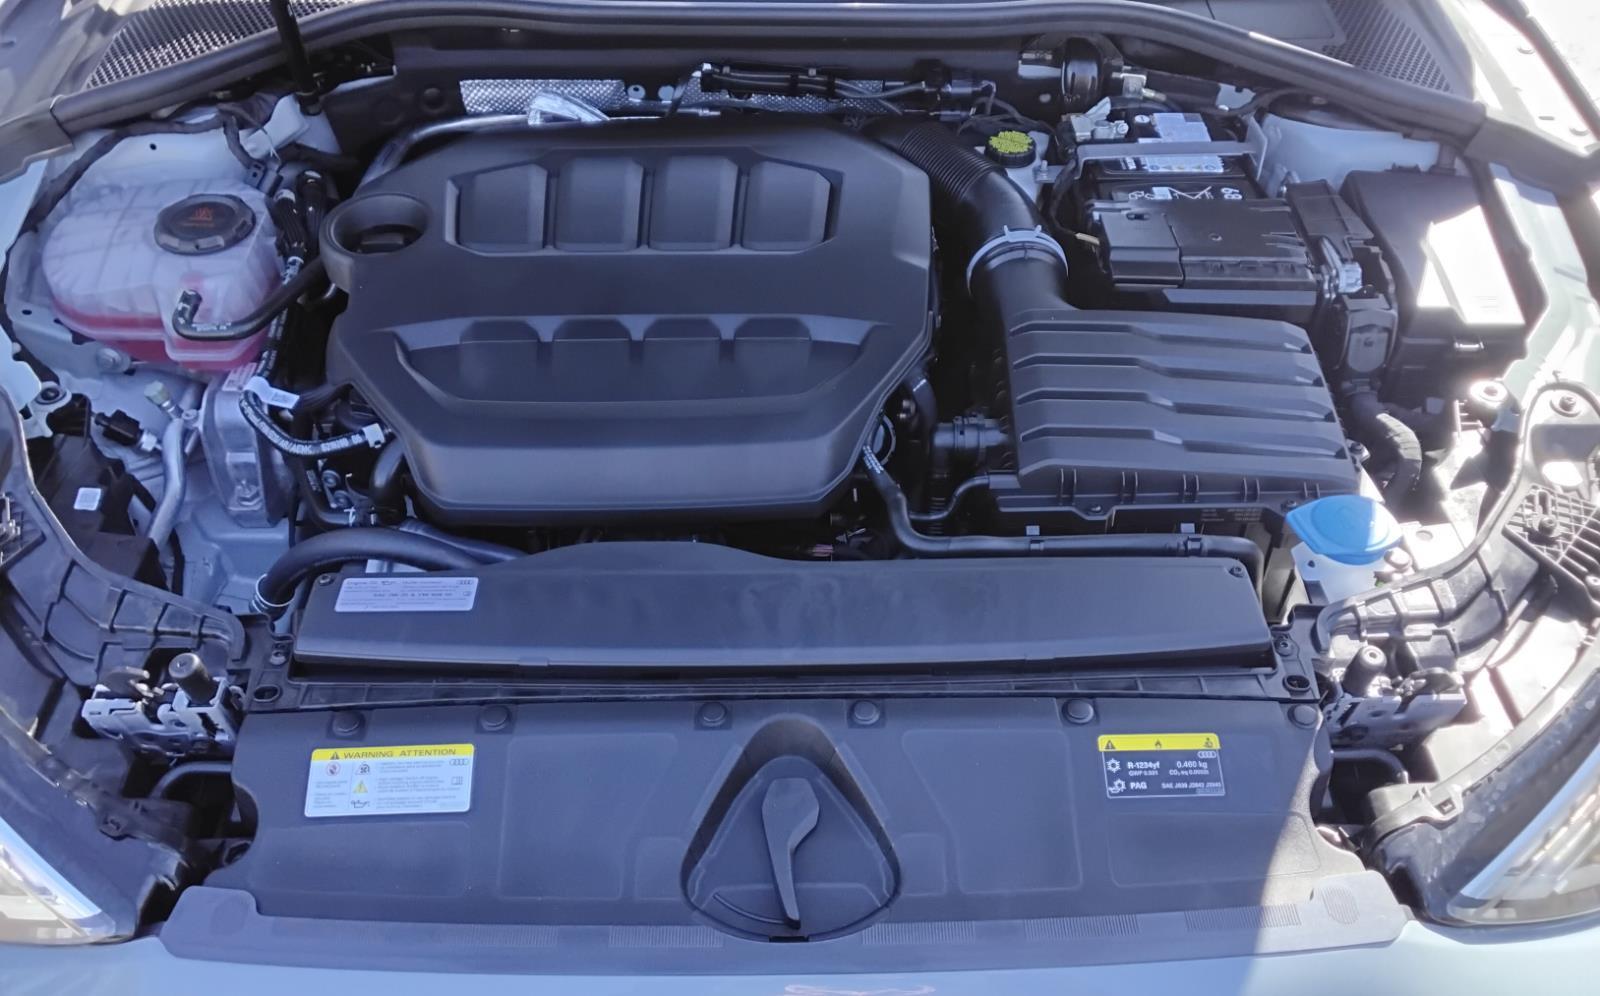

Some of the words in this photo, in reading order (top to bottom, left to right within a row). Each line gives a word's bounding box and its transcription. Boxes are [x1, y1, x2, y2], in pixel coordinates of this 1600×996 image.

[344, 750, 394, 759] WARNING
[399, 748, 457, 757] ATTENTION
[1127, 761, 1160, 769] R-1234yf
[1198, 760, 1208, 769] kg
[1130, 782, 1148, 790] PAG
